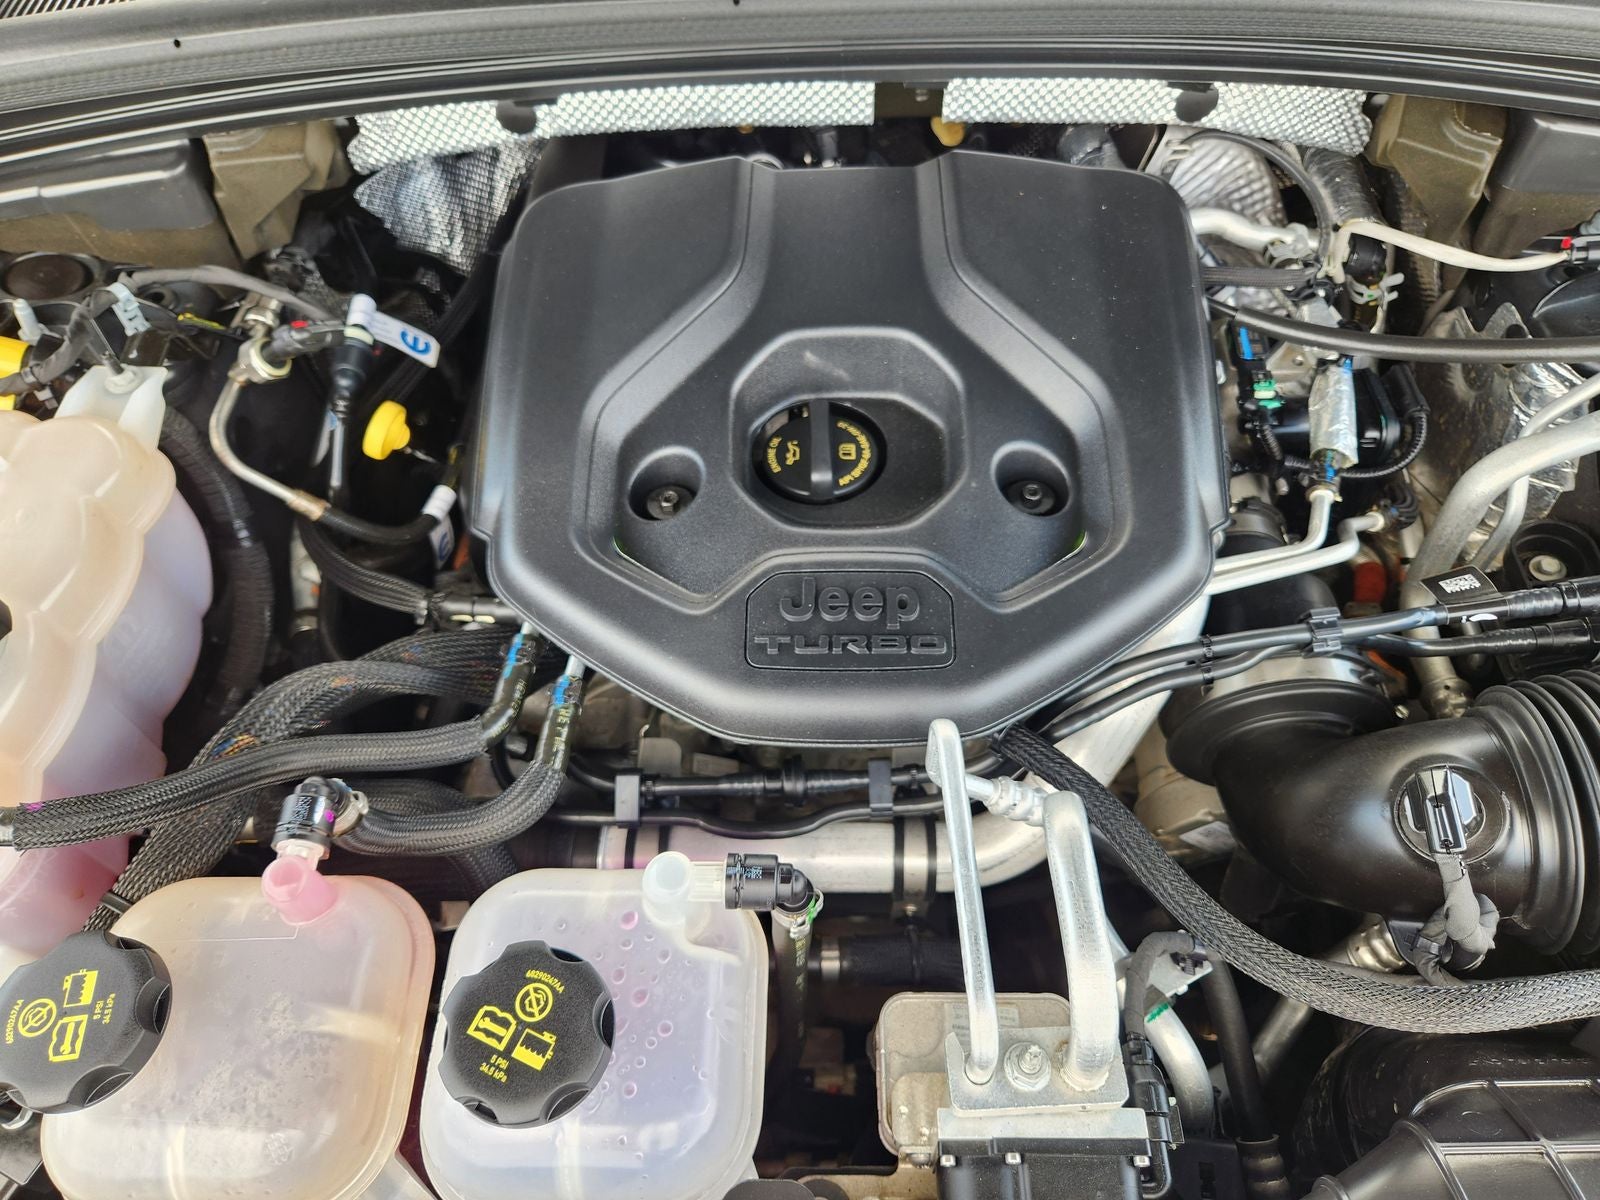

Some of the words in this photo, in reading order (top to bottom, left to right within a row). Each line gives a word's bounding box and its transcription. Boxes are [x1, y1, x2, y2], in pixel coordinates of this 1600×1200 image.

[779, 576, 920, 630] Jeep
[754, 635, 947, 655] TURBO
[94, 1000, 104, 1014] PSI
[490, 1054, 498, 1063] 5
[495, 1056, 509, 1070] PSI
